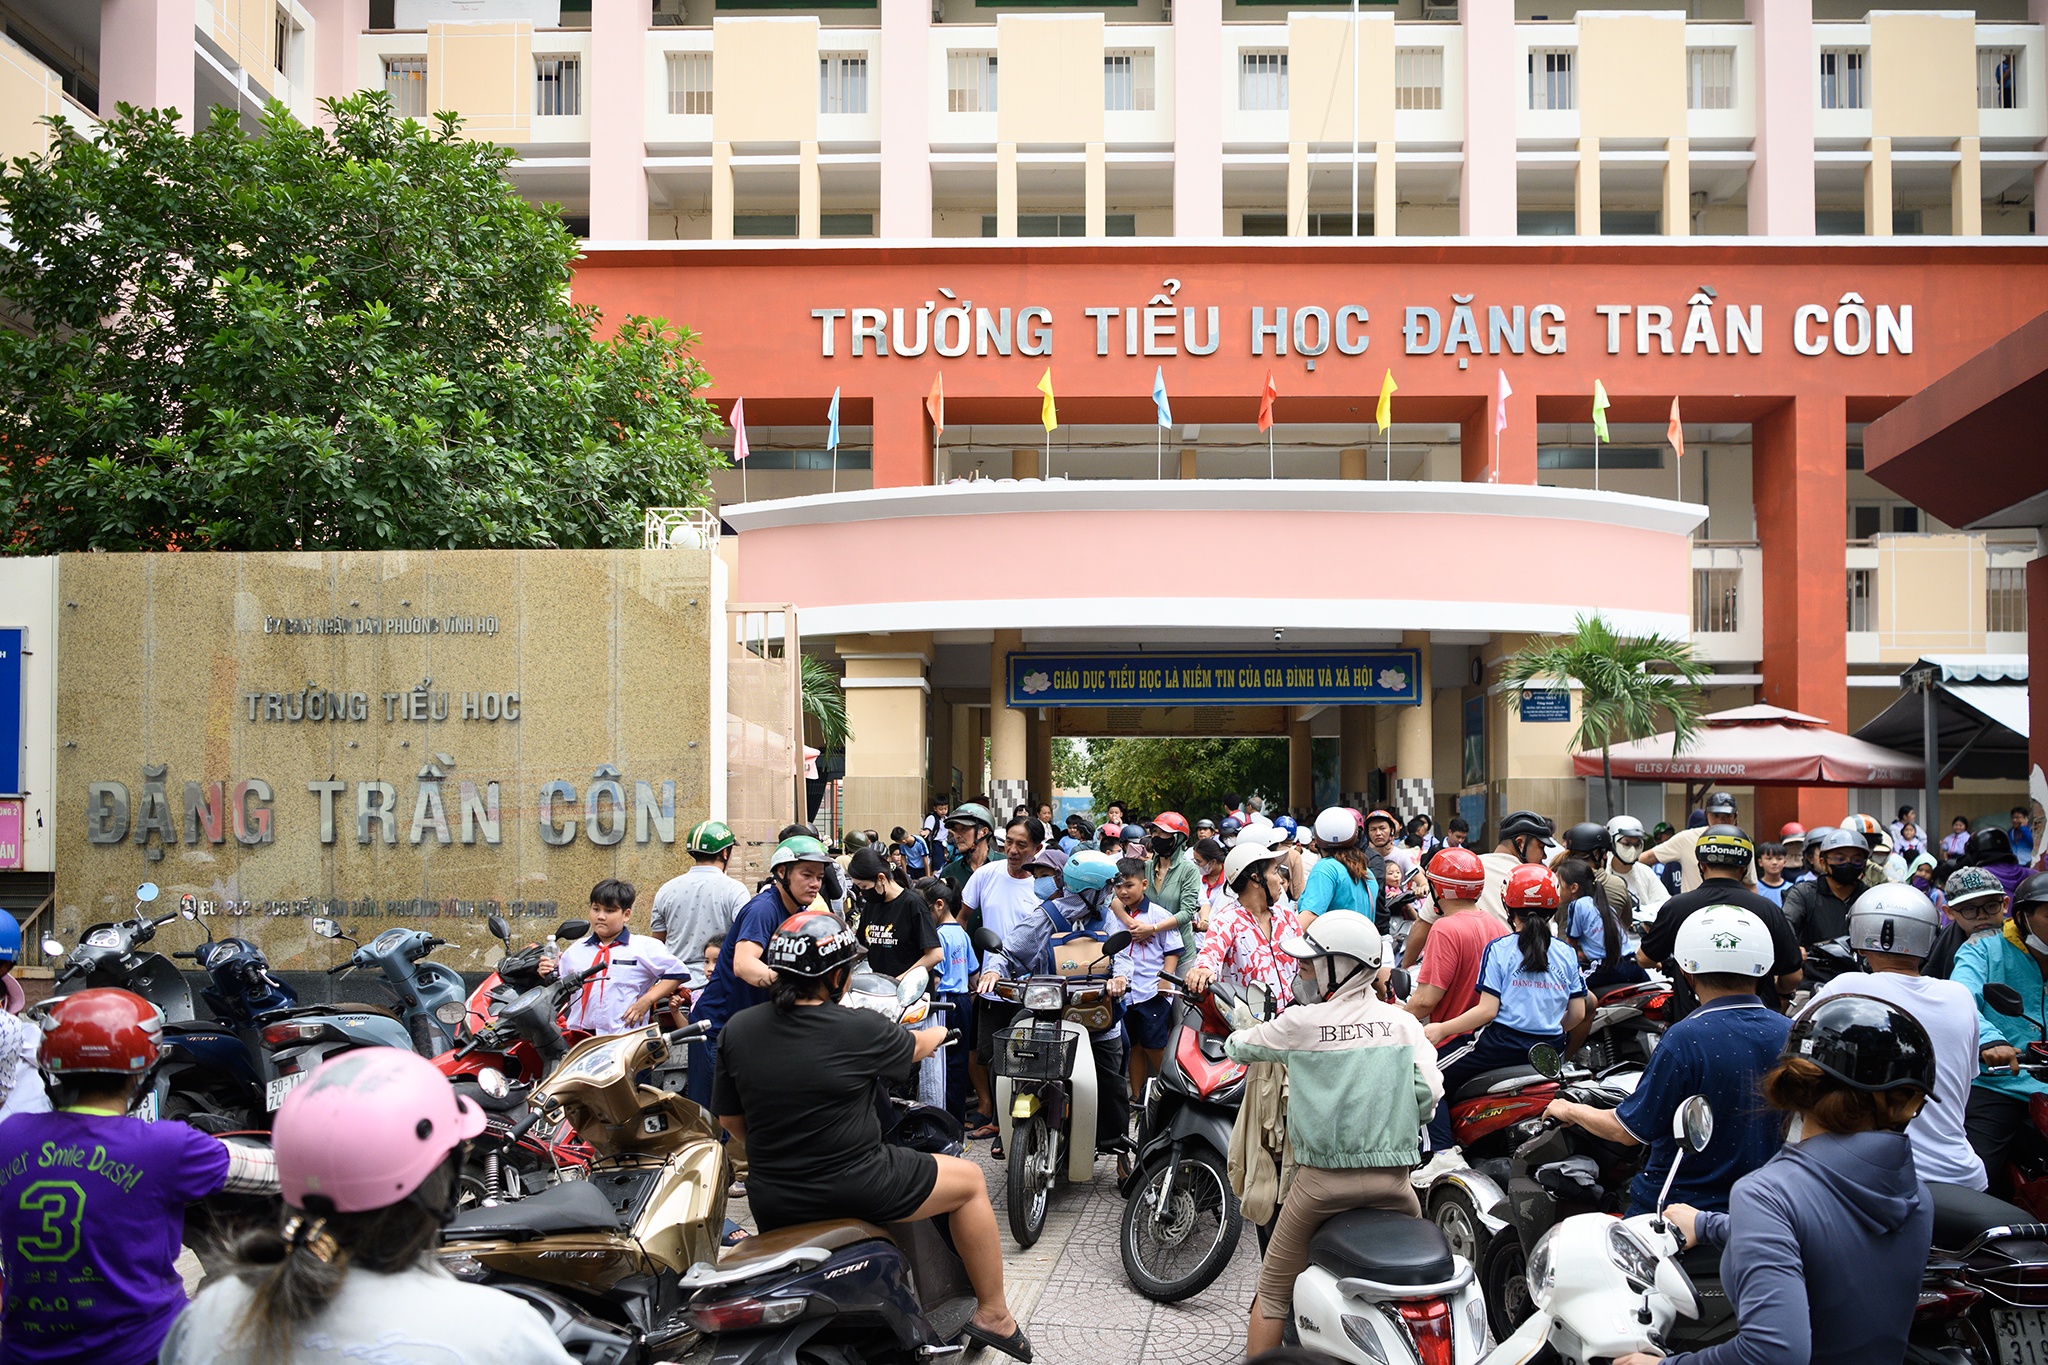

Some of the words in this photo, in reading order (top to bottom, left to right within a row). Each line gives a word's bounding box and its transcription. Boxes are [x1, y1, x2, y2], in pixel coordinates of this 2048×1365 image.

[811, 287, 1053, 356] TRƯỜNG
[1085, 278, 1220, 356] TIỂU
[1251, 304, 1370, 371] HỌC
[1402, 294, 1567, 370] ĐẶNG
[1596, 285, 1763, 354] TRẦN
[1792, 292, 1913, 356] CÔN
[477, 614, 500, 636] HỘI
[1053, 666, 1080, 690] GIÁO
[1082, 670, 1106, 692] DỤC
[1108, 664, 1136, 689] TIỂU
[1138, 670, 1162, 692] HỌC
[1165, 666, 1180, 688] LÀ
[1182, 664, 1212, 688] NIỀM
[1215, 670, 1235, 688] TIN
[1238, 664, 1262, 688] CỦA
[1264, 668, 1284, 688] GIA
[1286, 664, 1314, 687] ĐÌNH
[1318, 664, 1333, 687] VÀ
[1353, 664, 1374, 691] HỘI
[245, 679, 368, 722] TRƯỜNG
[382, 677, 448, 722] TIỂU
[1635, 763, 1662, 773] IELTS
[1671, 764, 1692, 774] SAT
[1694, 764, 1701, 774] &
[1704, 764, 1746, 774] JUNIOR
[86, 762, 274, 862] ĐẶNG
[307, 752, 501, 845] TRẦN
[538, 762, 676, 846] CÔN
[716, 829, 732, 840] Grab
[1700, 844, 1748, 857] McDonald's
[508, 900, 558, 918] TP.HCM
[1319, 1021, 1392, 1042] BENY
[38, 1141, 85, 1168] Smile
[87, 1145, 144, 1194] Dash!
[17, 1180, 86, 1262] 3
[538, 1250, 564, 1258] AIR
[566, 1250, 606, 1258] BLADE
[824, 1260, 868, 1280] VISION
